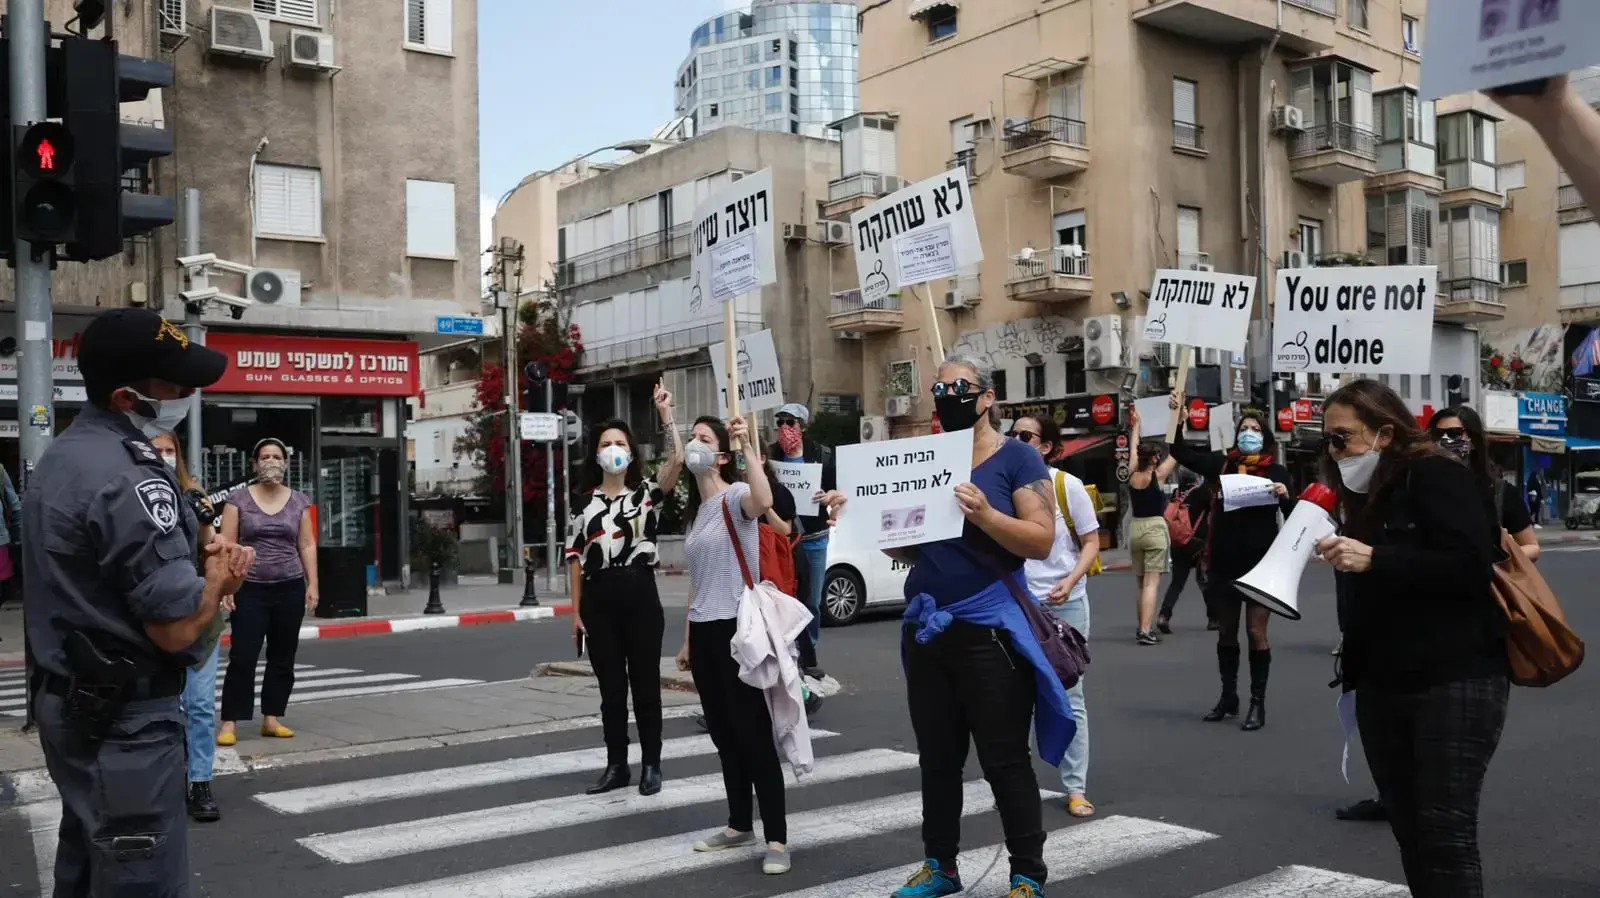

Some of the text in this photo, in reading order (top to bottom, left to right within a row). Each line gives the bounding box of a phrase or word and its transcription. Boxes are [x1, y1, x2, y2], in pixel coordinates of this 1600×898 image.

[725, 189, 768, 238] רוצה
[857, 176, 964, 254] לא שותקת
[1155, 278, 1249, 310] לא שותקת
[1285, 276, 1426, 311] You are not
[1314, 324, 1384, 365] alone
[236, 350, 408, 372] המרכז למשקפי שמש
[245, 373, 403, 385] SUN GLASSES & OPTICS
[748, 376, 776, 398] אנחנו
[1527, 399, 1564, 413] CHANGE
[875, 449, 935, 468] הבית הוא
[798, 480, 811, 490] לא
[856, 468, 952, 497] לא מרחב בטוח
